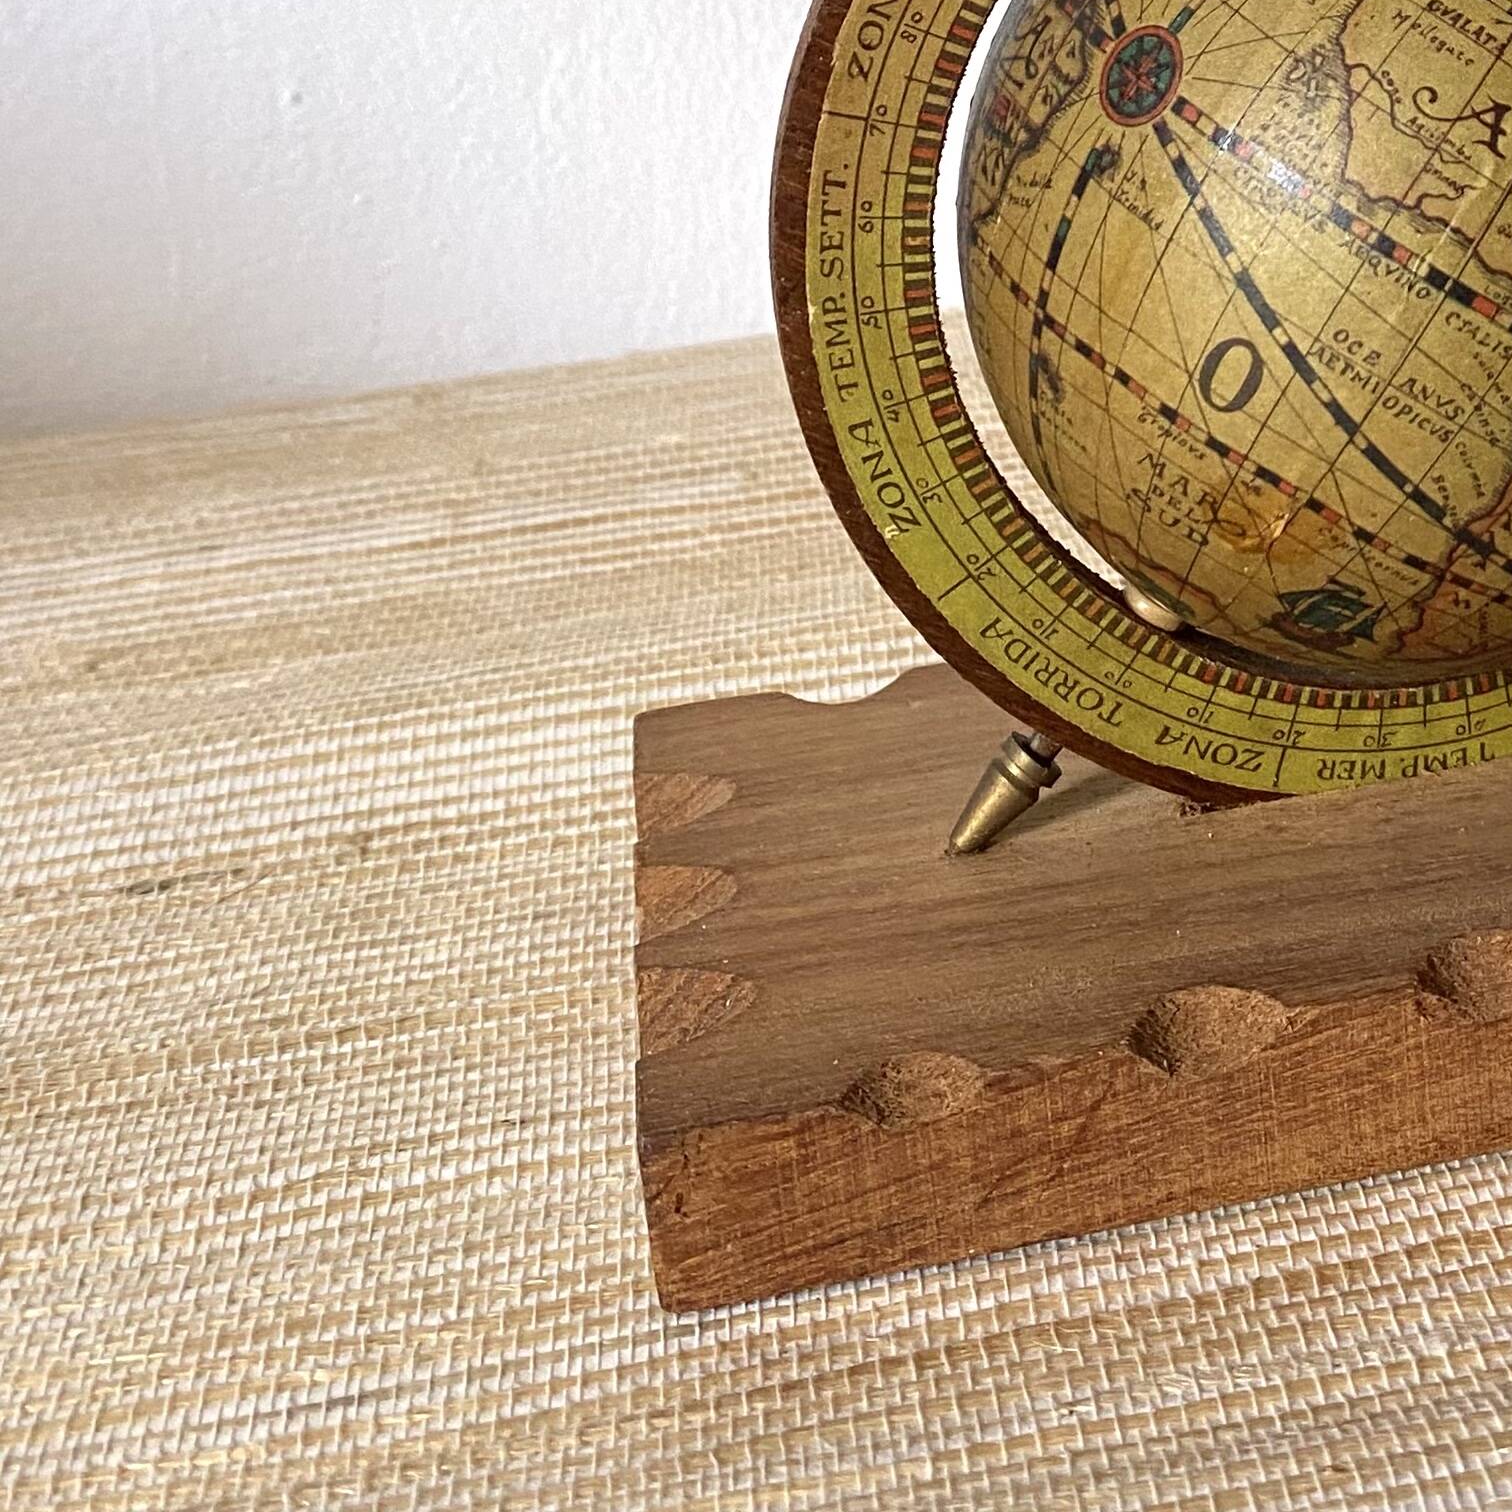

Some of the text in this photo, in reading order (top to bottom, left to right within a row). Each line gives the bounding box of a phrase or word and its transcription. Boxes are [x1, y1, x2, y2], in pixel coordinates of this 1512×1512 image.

[1198, 337, 1265, 414] O
[848, 418, 922, 536] ZONA
[978, 617, 1267, 774] ZONA TORRIDA
[1315, 757, 1387, 782] MER
